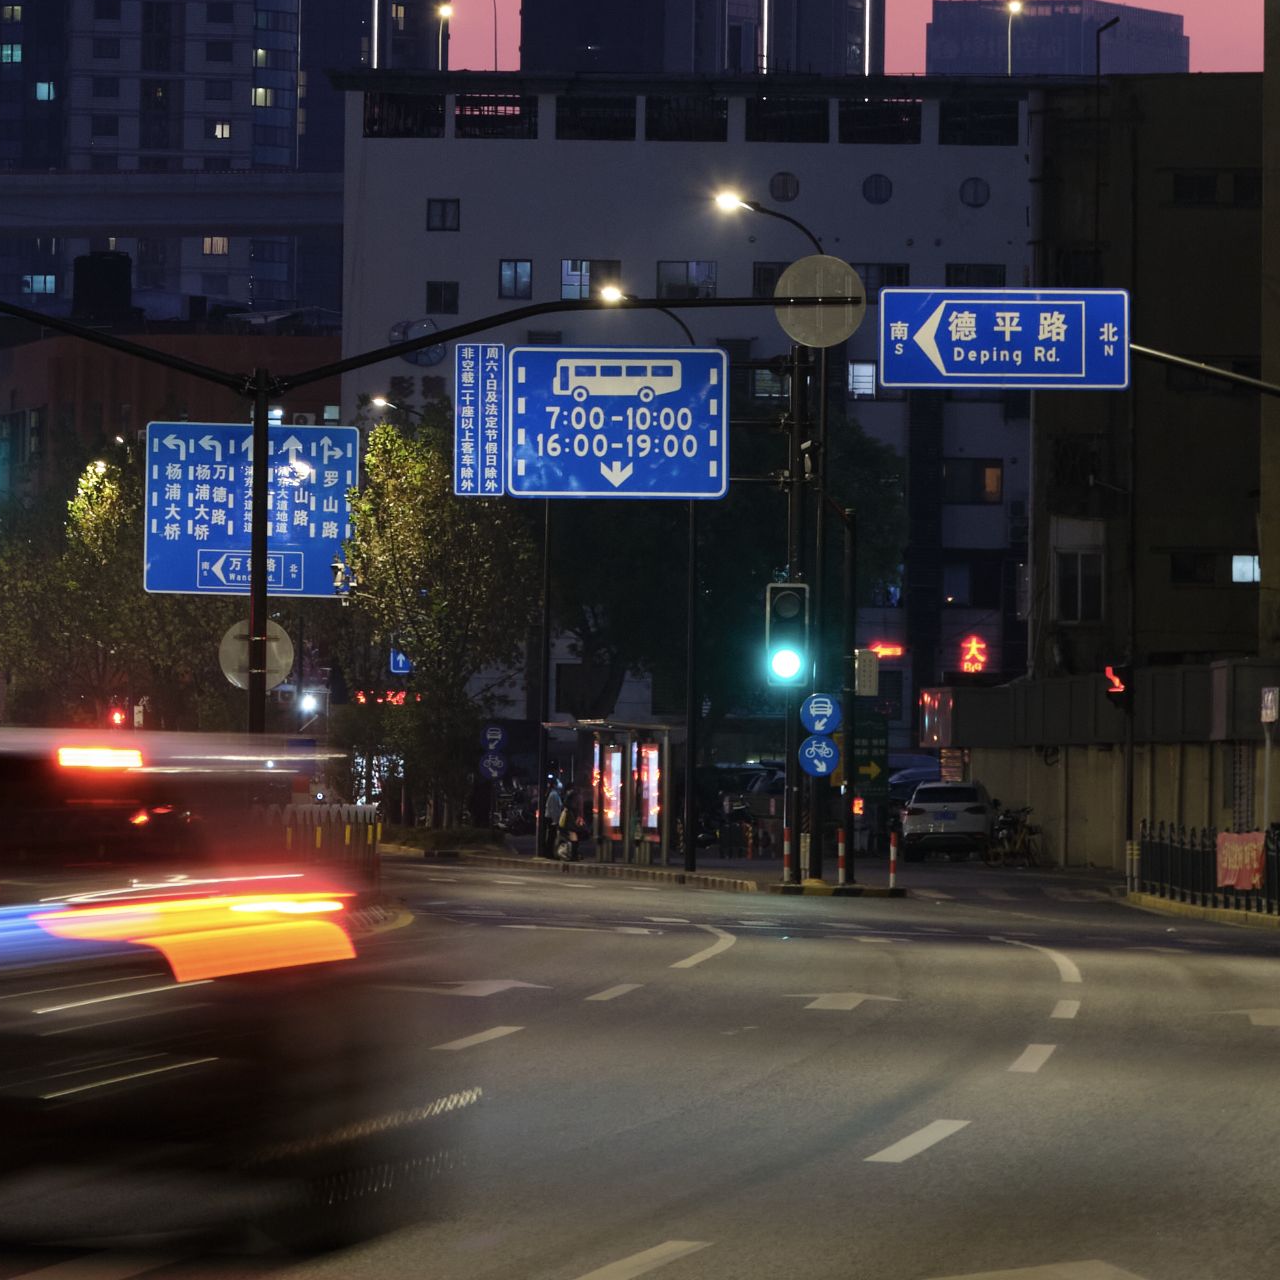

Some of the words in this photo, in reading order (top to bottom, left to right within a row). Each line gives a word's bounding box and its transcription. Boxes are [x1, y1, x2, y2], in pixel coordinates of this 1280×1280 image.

[890, 321, 909, 340] 南
[948, 311, 1068, 342] 德平路
[1099, 323, 1118, 342] 北
[894, 343, 904, 355] S
[953, 347, 1022, 366] Deping
[1034, 346, 1061, 362] Rd.
[1104, 345, 1114, 357] N
[460, 347, 475, 492] 非空载二十座以上客车除外
[484, 347, 499, 492] 周六、日及法定节假日除外
[536, 433, 698, 458] 16:00-19:00
[164, 463, 182, 541] 杨浦大桥
[194, 463, 211, 541] 杨浦大桥
[211, 464, 227, 526] 万德路
[275, 465, 289, 534] 浦东大道地道
[321, 470, 339, 539] 罗山路
[201, 561, 210, 571] 南
[289, 563, 299, 573] 北
[961, 637, 987, 663] 大
